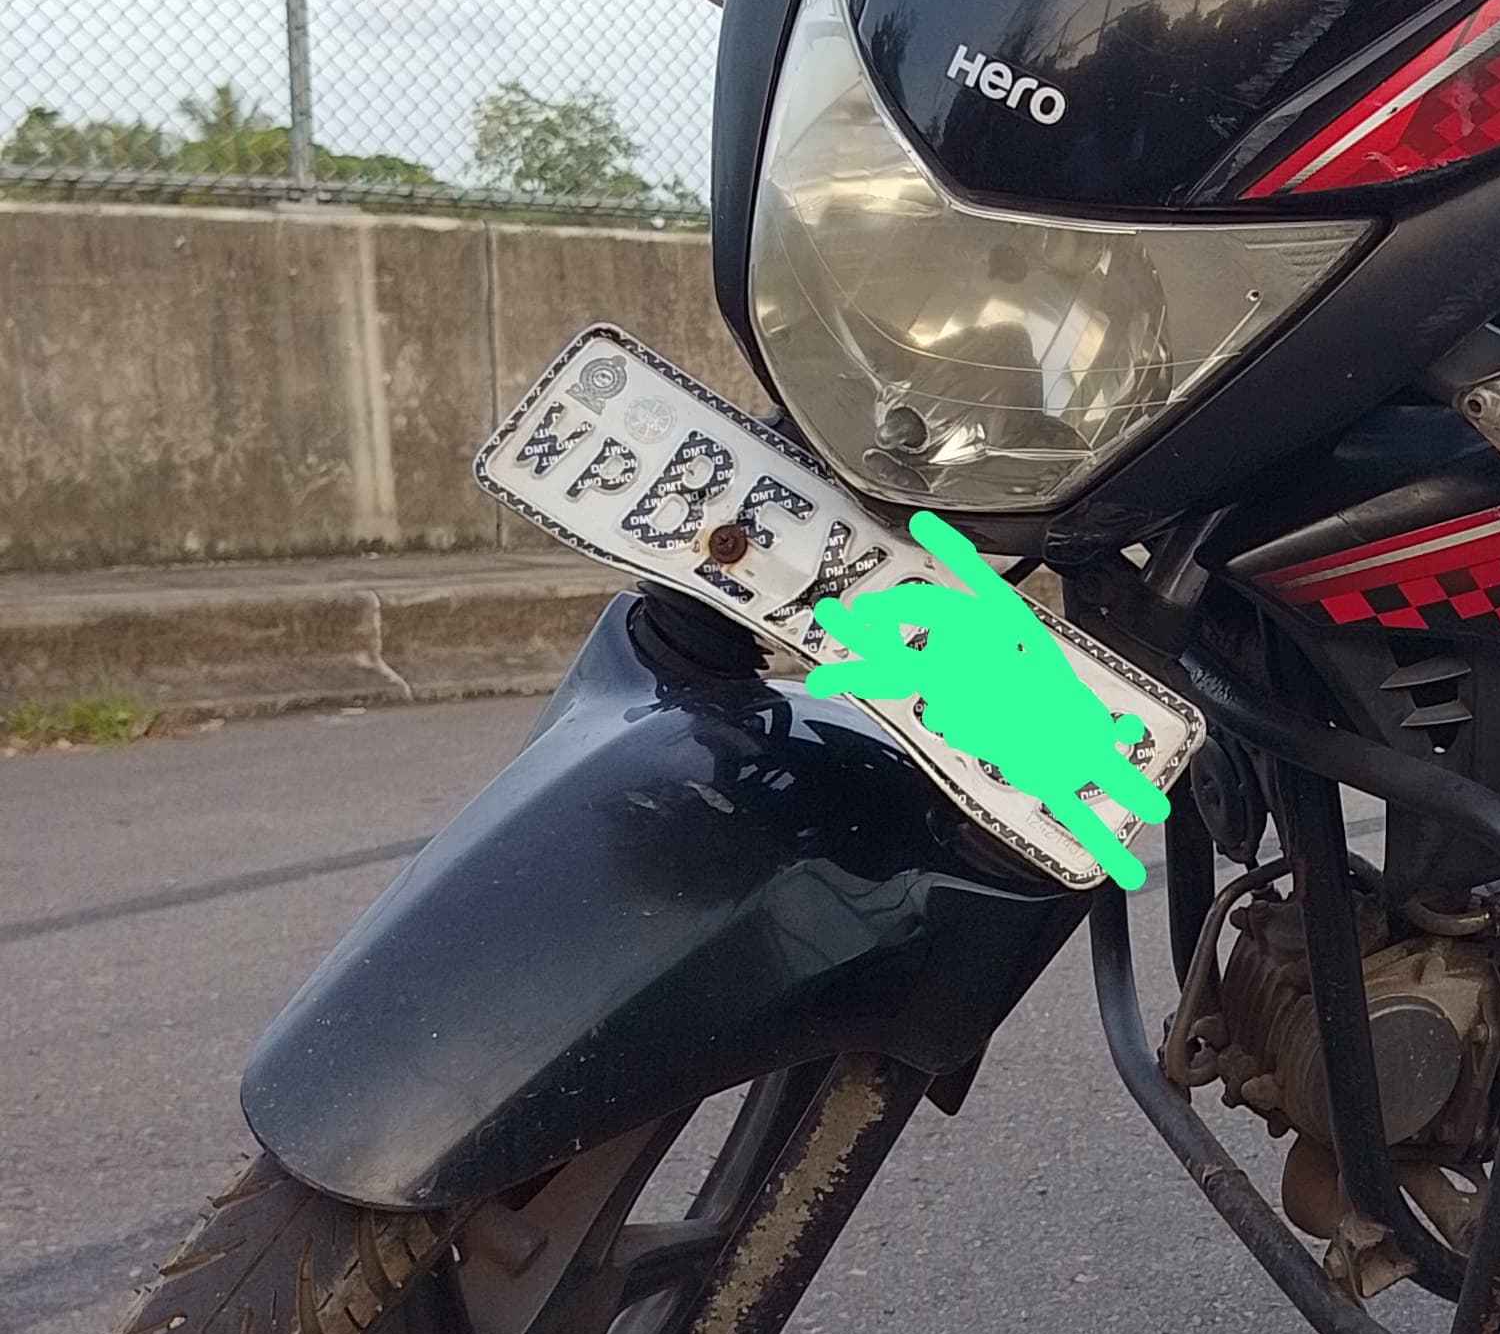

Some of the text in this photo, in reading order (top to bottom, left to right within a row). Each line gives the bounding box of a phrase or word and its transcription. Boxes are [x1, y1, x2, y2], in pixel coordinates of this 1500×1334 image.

[947, 44, 1066, 125] Hero
[515, 400, 888, 654] WP BEX
